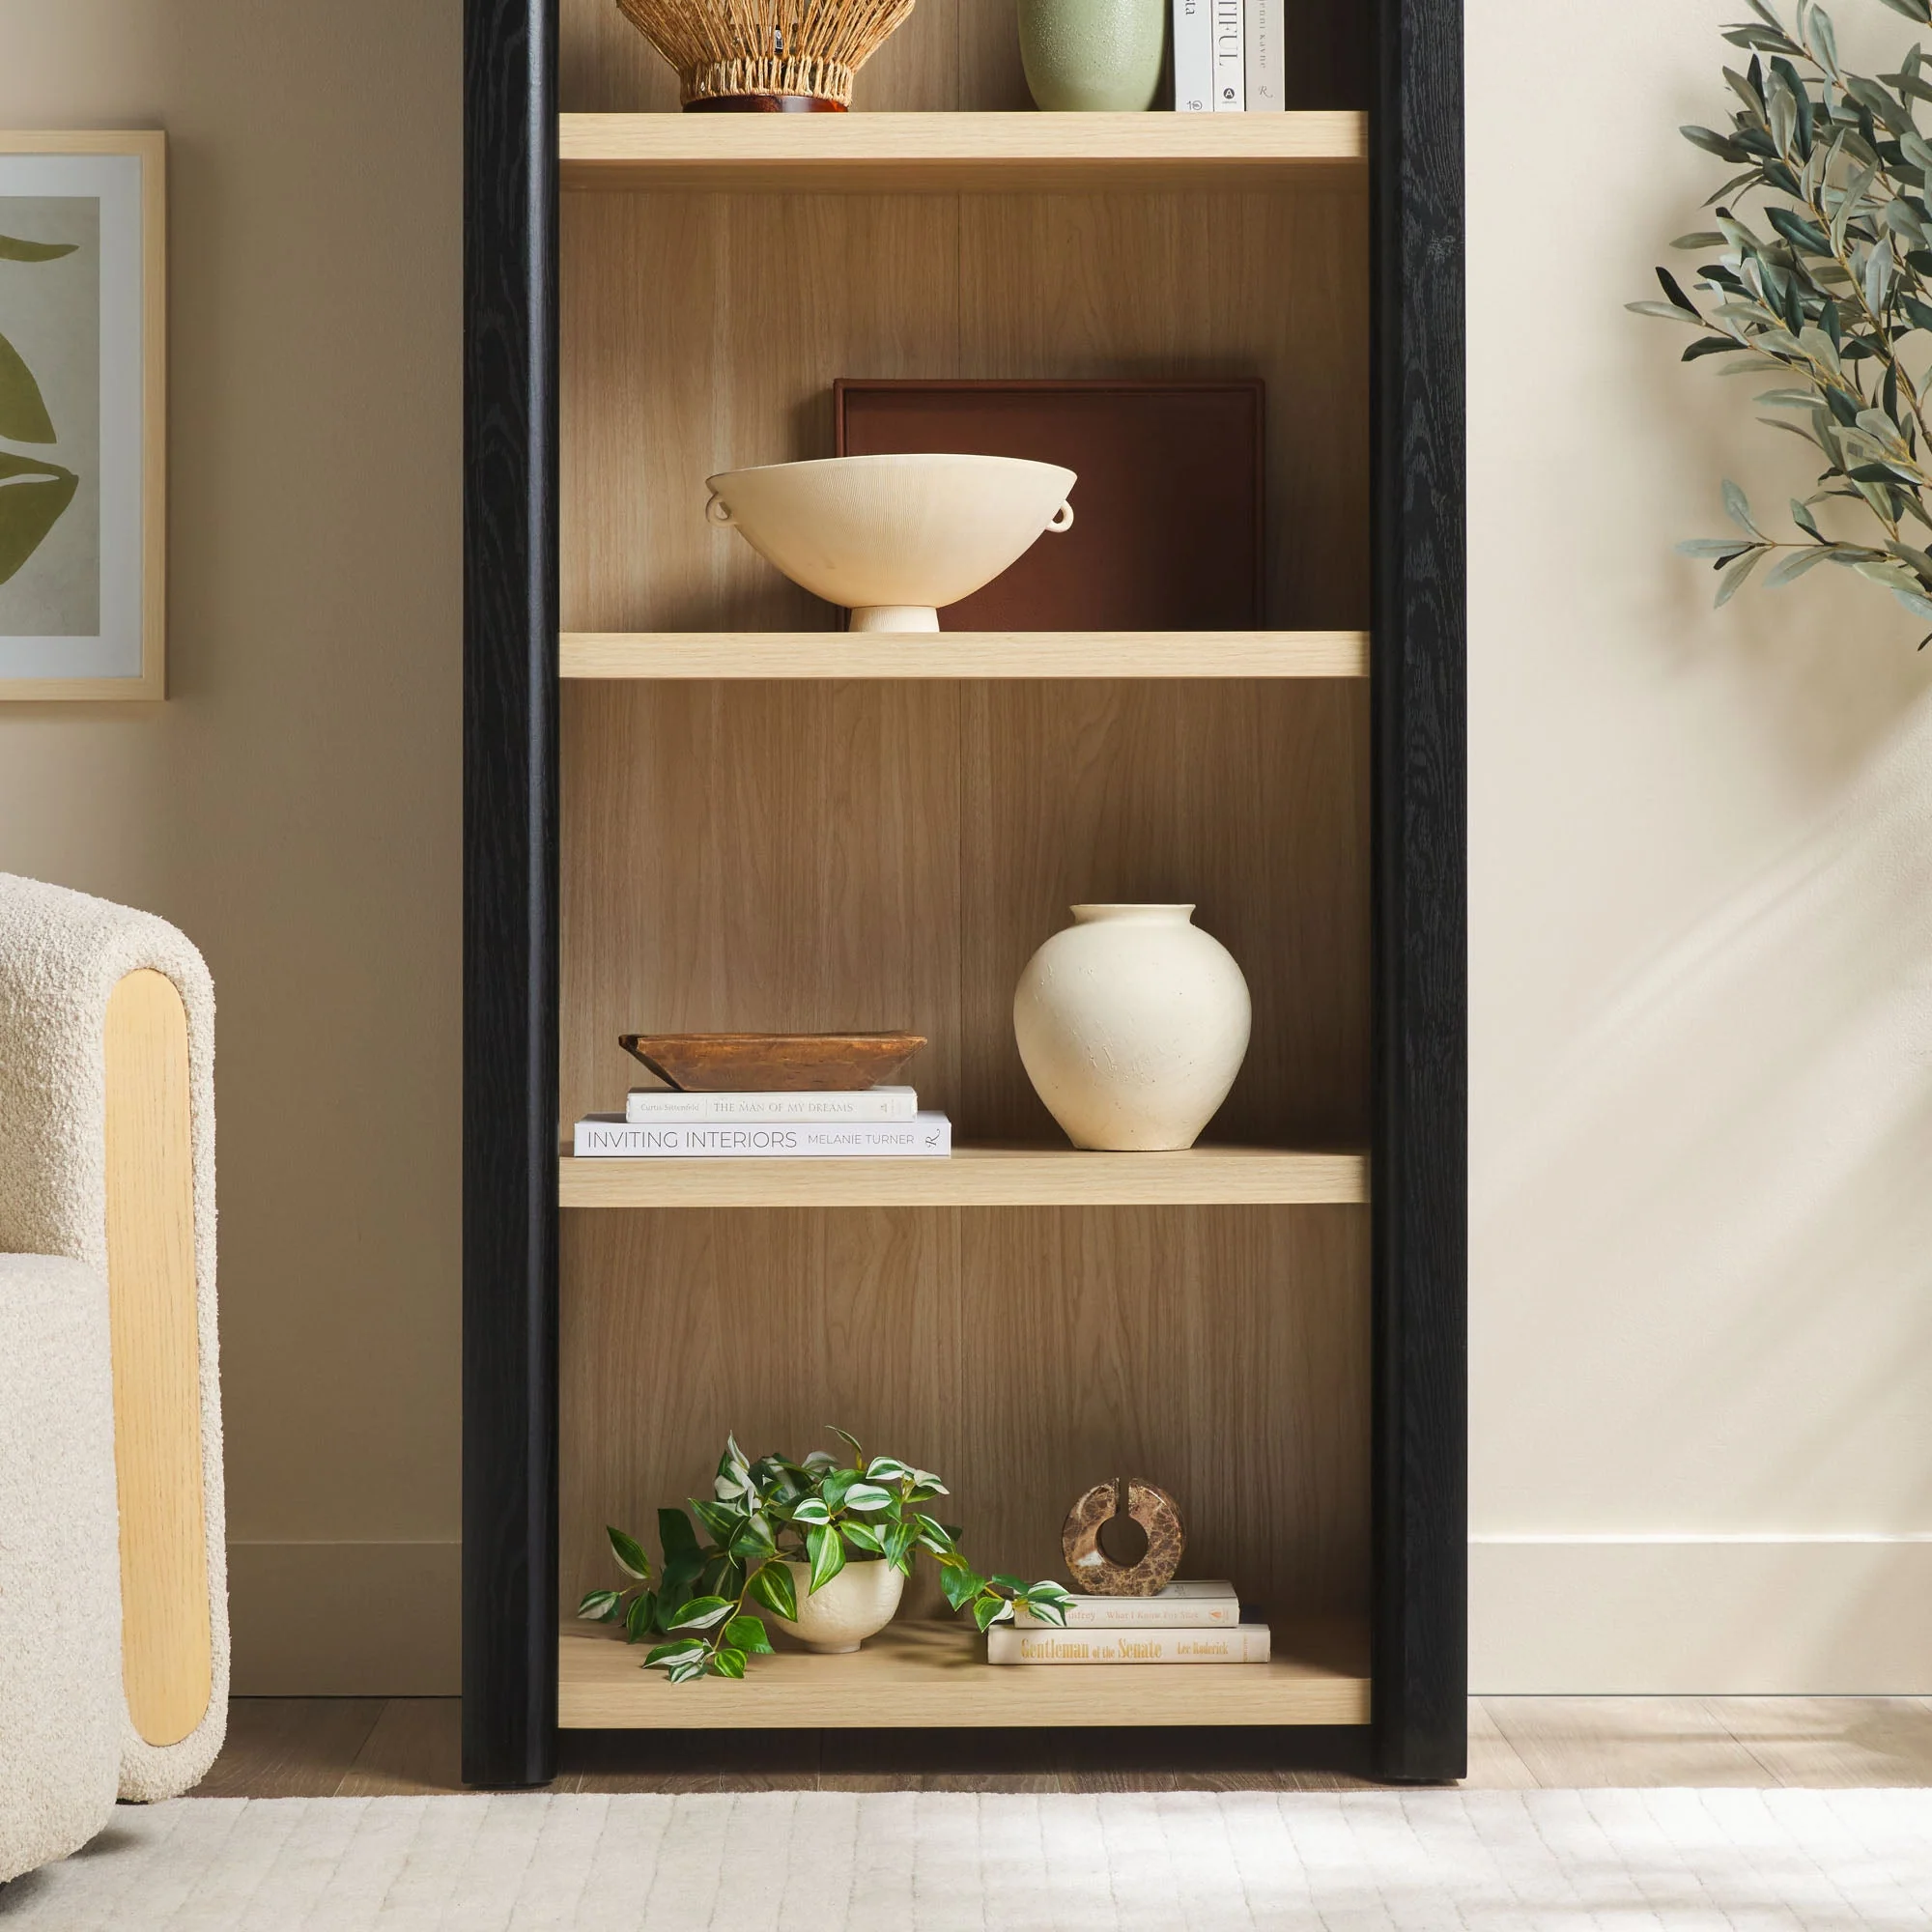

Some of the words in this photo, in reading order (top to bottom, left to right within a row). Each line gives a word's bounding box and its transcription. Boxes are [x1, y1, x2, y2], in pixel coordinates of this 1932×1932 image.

[664, 1103, 699, 1112] Sittenfeld
[714, 1102, 734, 1112] THE
[738, 1102, 764, 1112] MAN
[768, 1102, 783, 1112] OF
[787, 1102, 805, 1112] MY
[808, 1102, 854, 1112] DREAMS
[588, 1131, 678, 1149] INVITING
[686, 1131, 797, 1149] INTERIORS
[808, 1134, 862, 1145] MELANIE
[866, 1134, 914, 1145] TURNER
[1065, 1610, 1095, 1622] infrey
[1021, 1638, 1089, 1659] Gentleman
[1102, 1646, 1116, 1658] the
[1118, 1638, 1162, 1659] Senate
[1177, 1642, 1191, 1655] Lee
